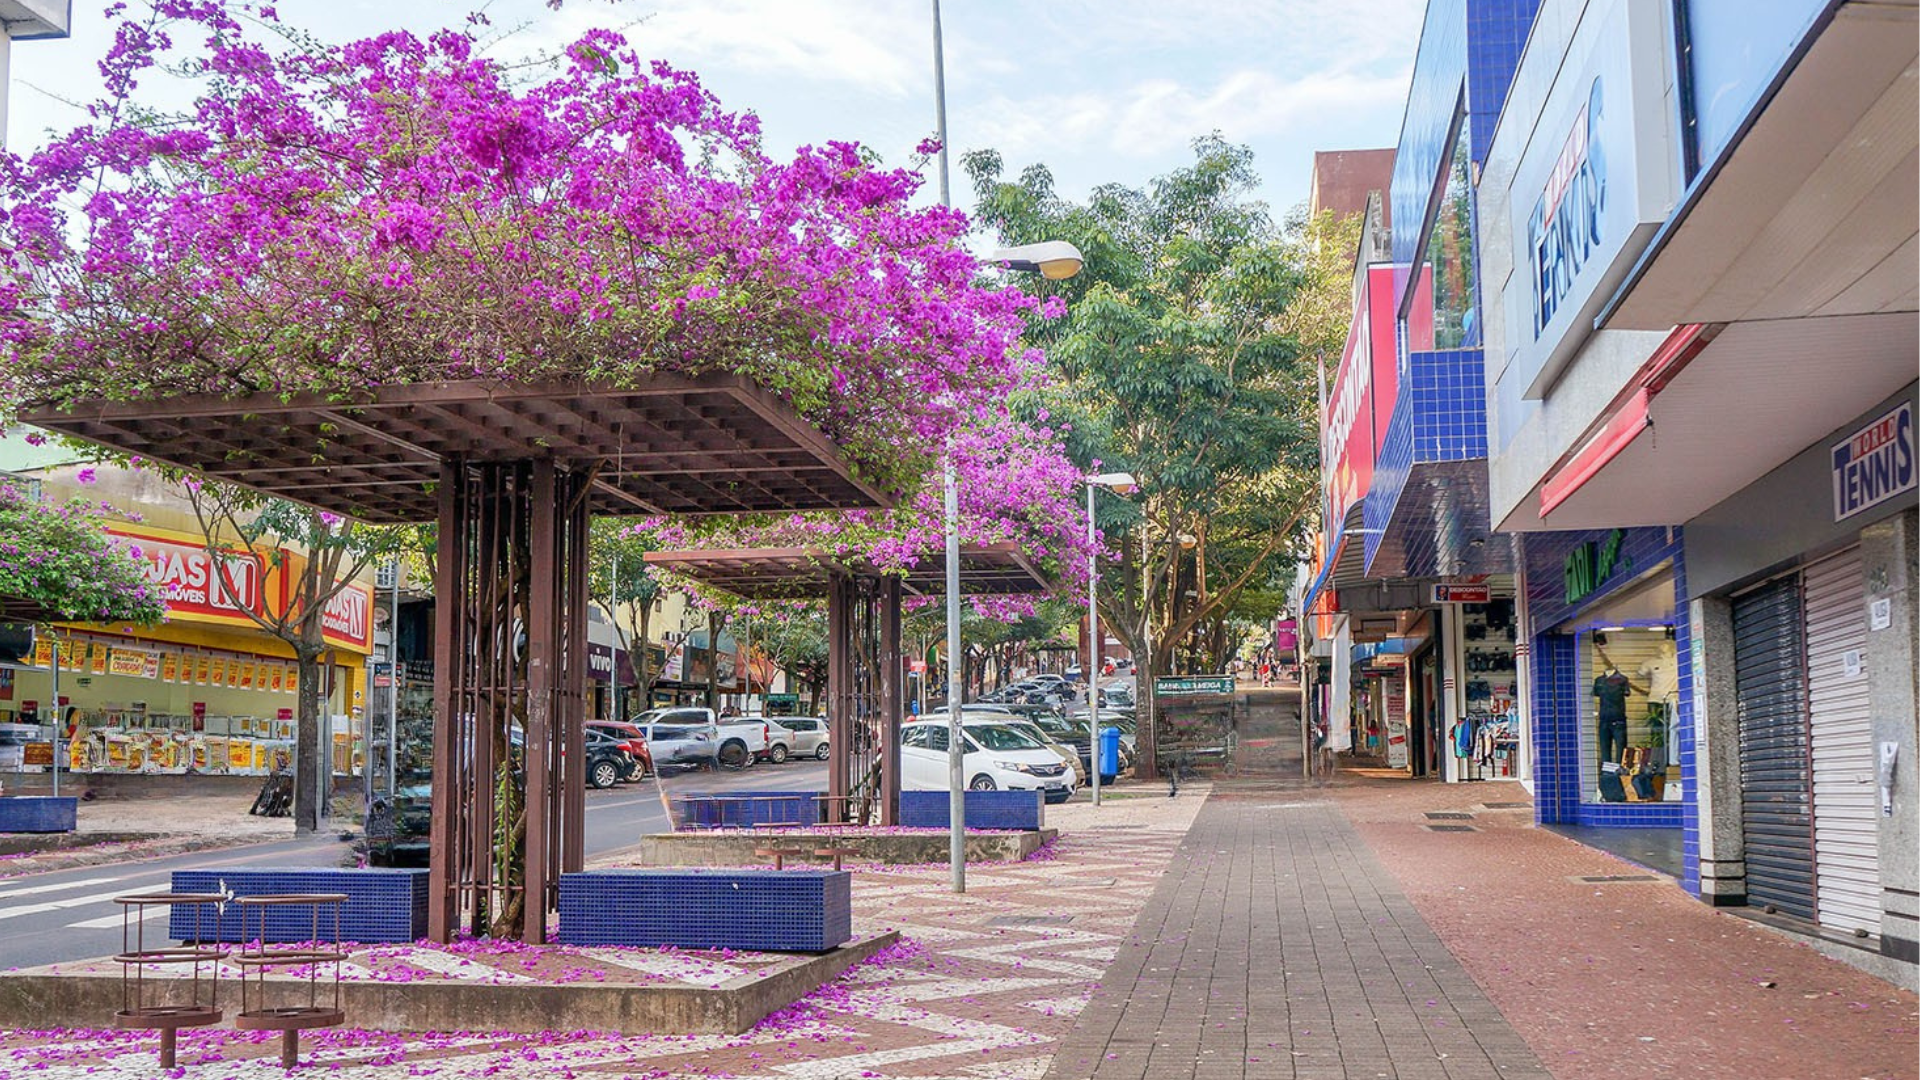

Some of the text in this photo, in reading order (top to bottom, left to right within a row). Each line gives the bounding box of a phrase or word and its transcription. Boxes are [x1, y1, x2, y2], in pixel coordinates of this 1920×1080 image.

[1853, 417, 1896, 457] WORLD
[1834, 409, 1911, 515] TENNIS
[590, 648, 612, 672] vivo
